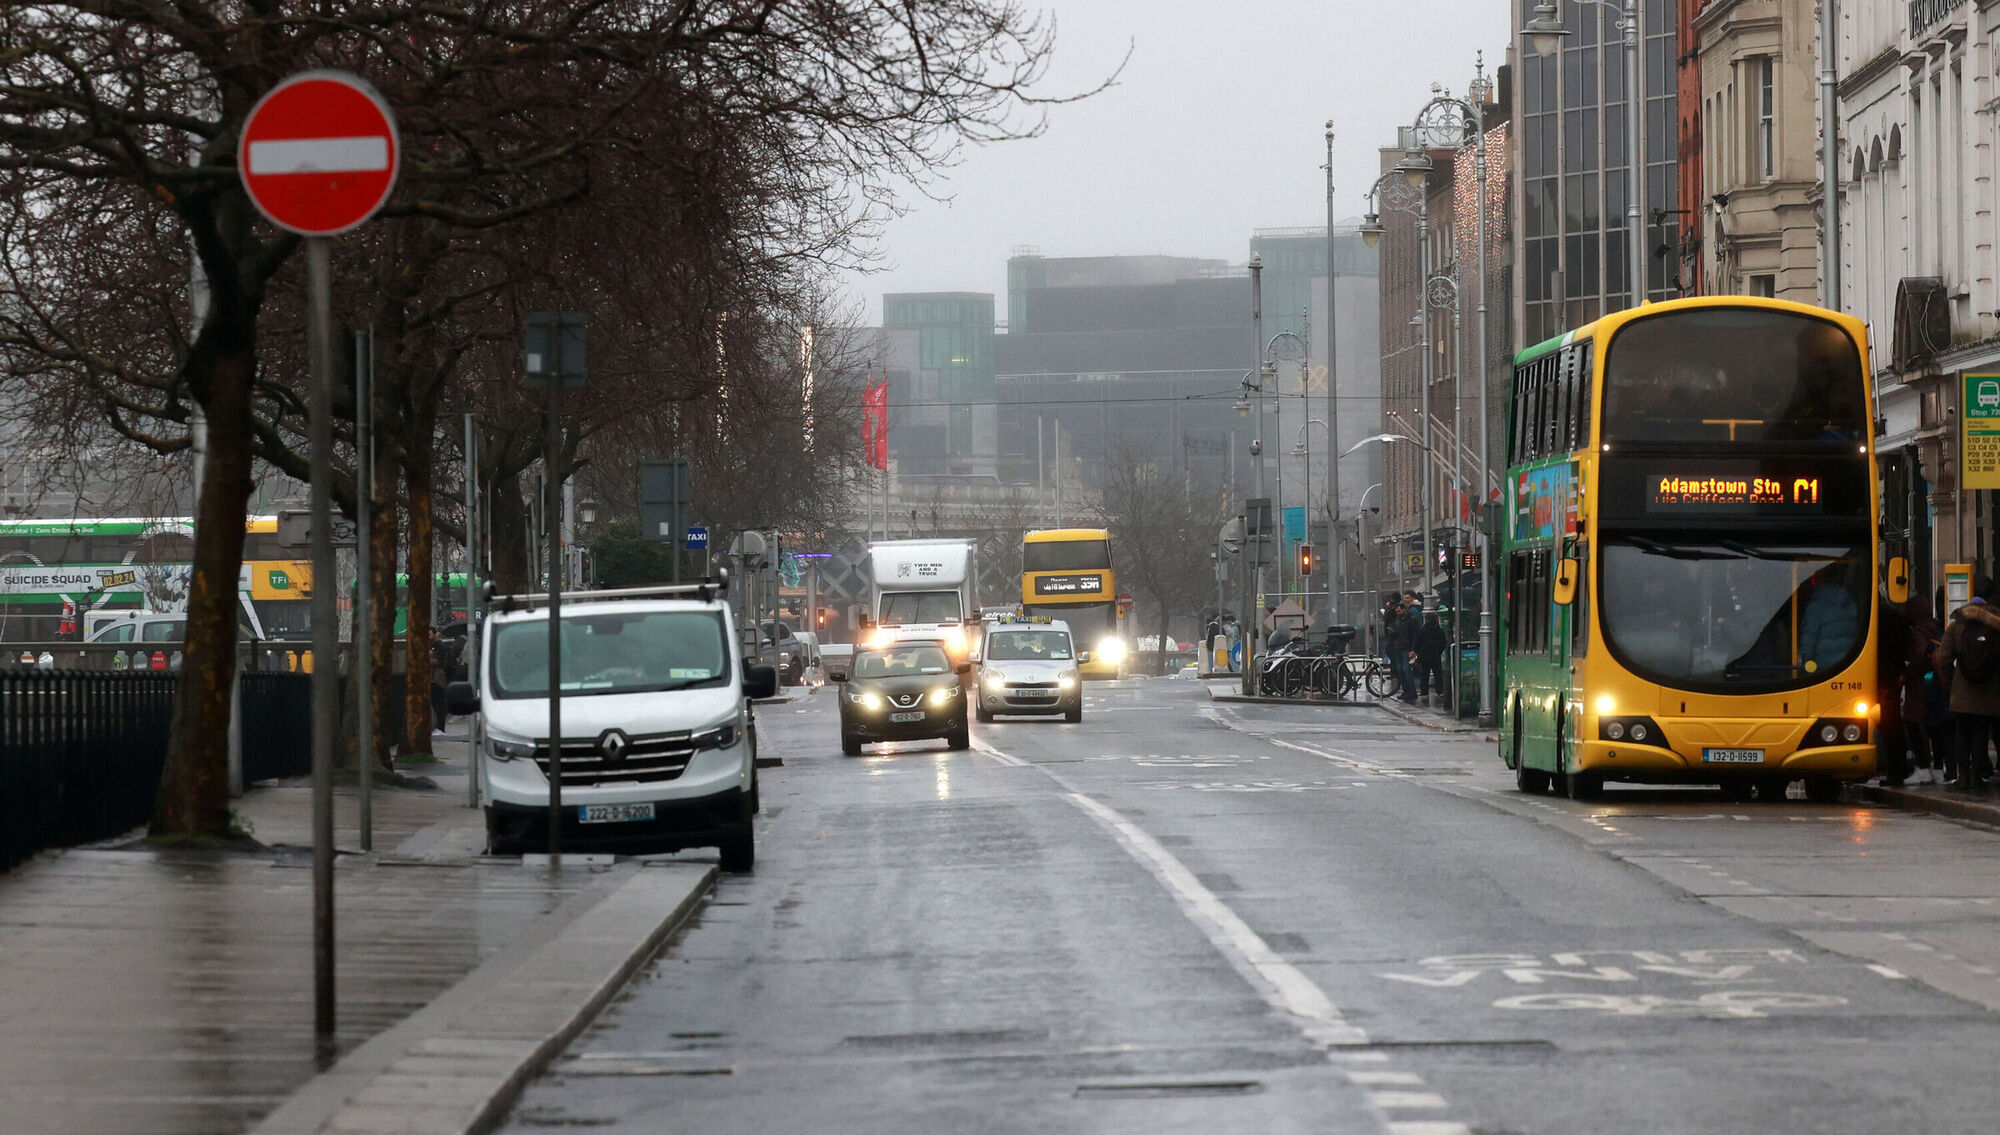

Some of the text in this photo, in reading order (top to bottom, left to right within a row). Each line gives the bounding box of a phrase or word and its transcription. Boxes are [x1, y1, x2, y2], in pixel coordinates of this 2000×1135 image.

[1659, 477, 1748, 494] Adamstown
[1752, 478, 1781, 495] Stn
[687, 533, 707, 541] TAXI
[4, 575, 91, 585] SUICIDE SQUAD
[103, 572, 134, 587] 02.02.24
[1830, 681, 1862, 690] GT 148
[1713, 751, 1758, 762] 132-D-11599
[589, 806, 651, 820] 222-D-16200
